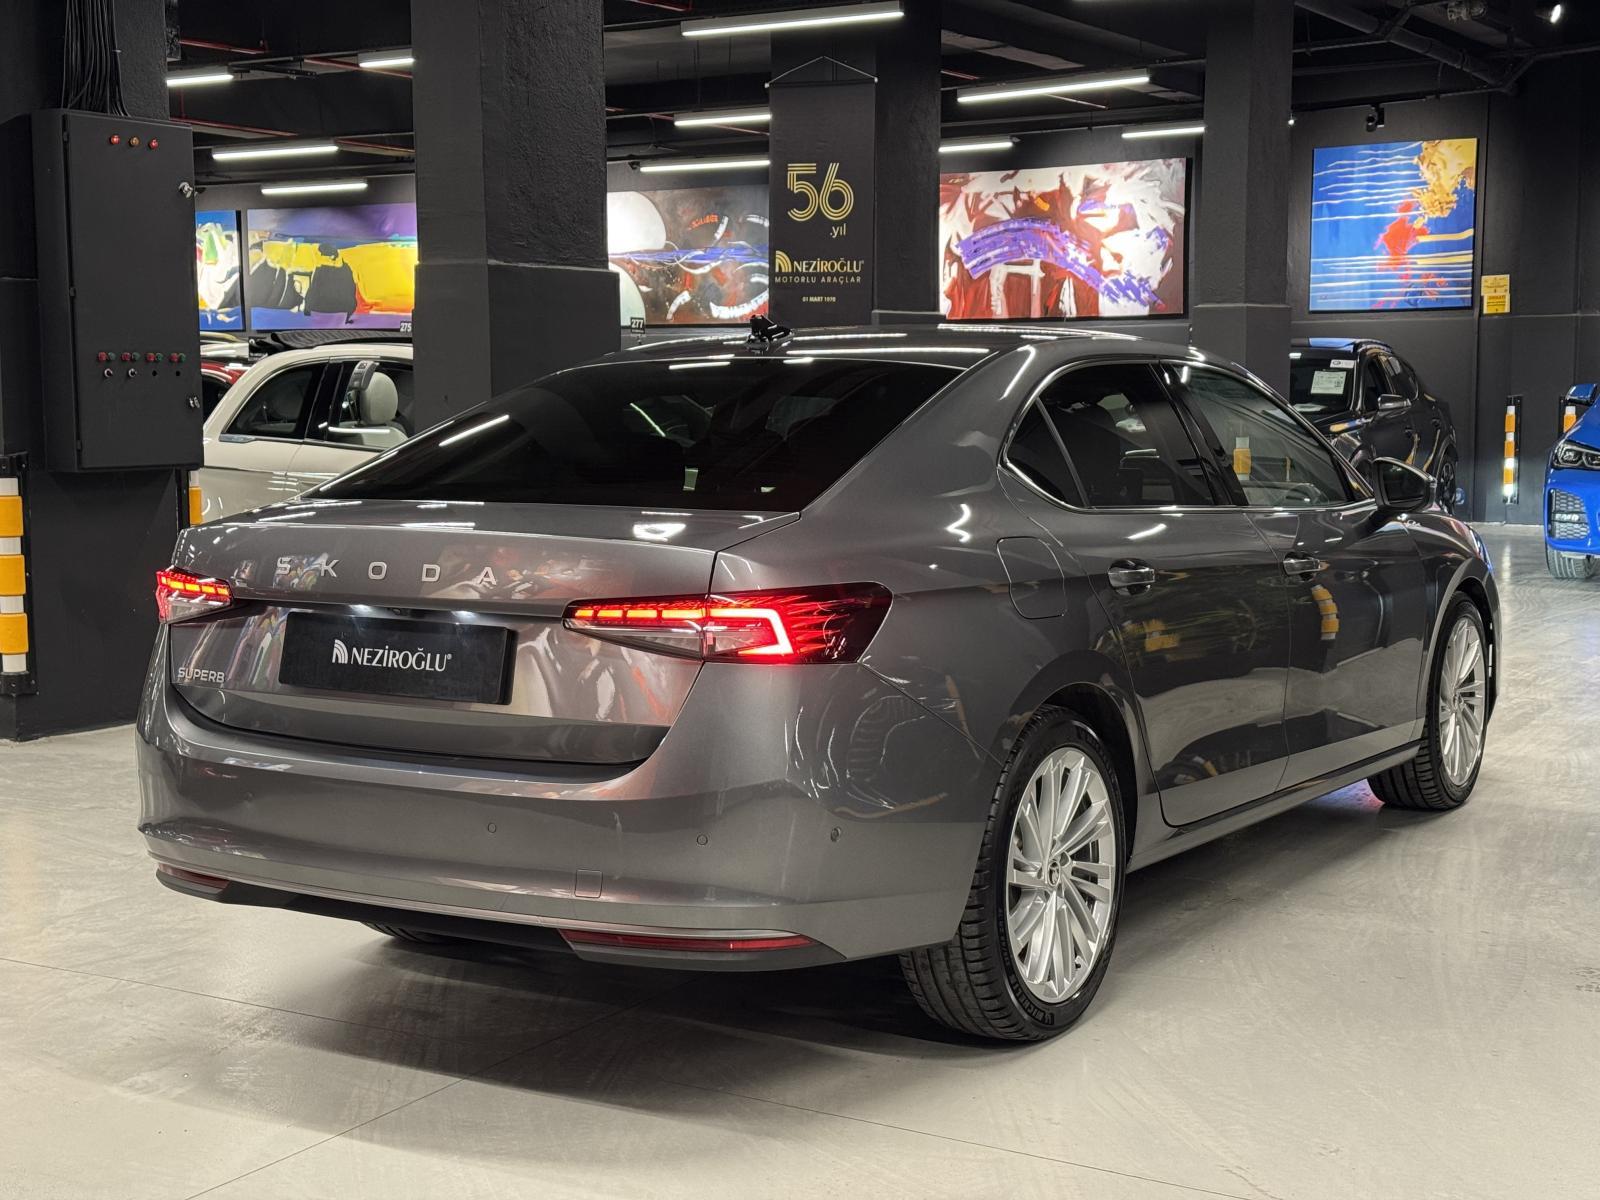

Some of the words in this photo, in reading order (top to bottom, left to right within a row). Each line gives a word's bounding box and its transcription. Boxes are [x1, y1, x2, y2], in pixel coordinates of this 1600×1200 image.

[787, 162, 854, 221] 56
[821, 276, 861, 284] ARAÇLAR
[400, 322, 412, 331] 275
[631, 319, 644, 328] 277
[177, 667, 225, 683] SUPERB
